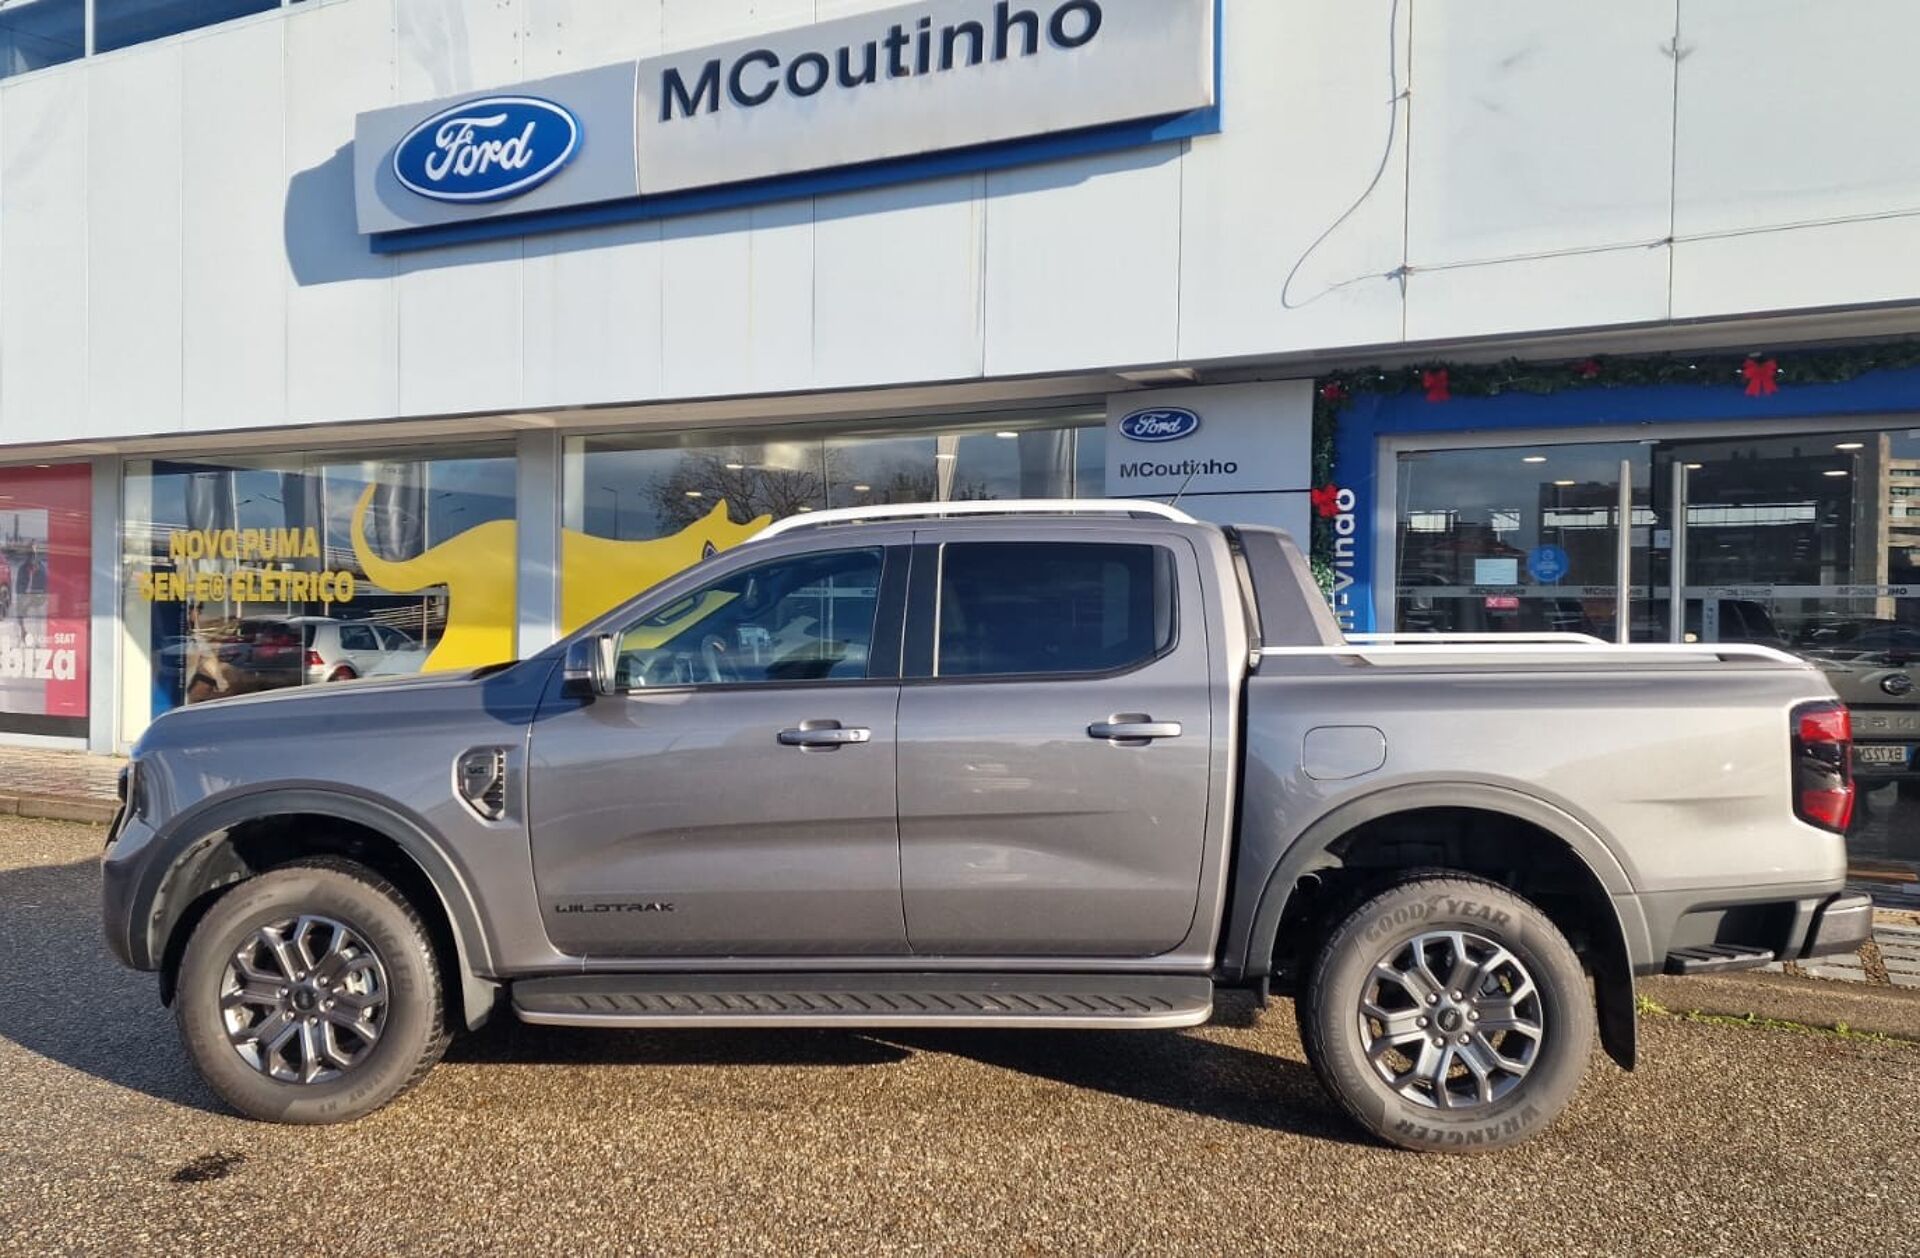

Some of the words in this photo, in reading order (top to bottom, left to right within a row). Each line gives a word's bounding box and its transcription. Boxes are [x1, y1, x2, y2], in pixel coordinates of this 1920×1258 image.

[658, 0, 1103, 121] MCoutinho
[425, 112, 536, 182] Ford
[1134, 413, 1181, 435] Ford
[1119, 458, 1238, 478] MCoutinho
[169, 528, 238, 560] NOVO
[242, 526, 320, 559] PUMA
[231, 563, 355, 603] ELÉTRICO
[54, 632, 77, 645] SEAT
[555, 902, 675, 914] WILDTRAK
[1395, 1105, 1542, 1146] WRANGLER
